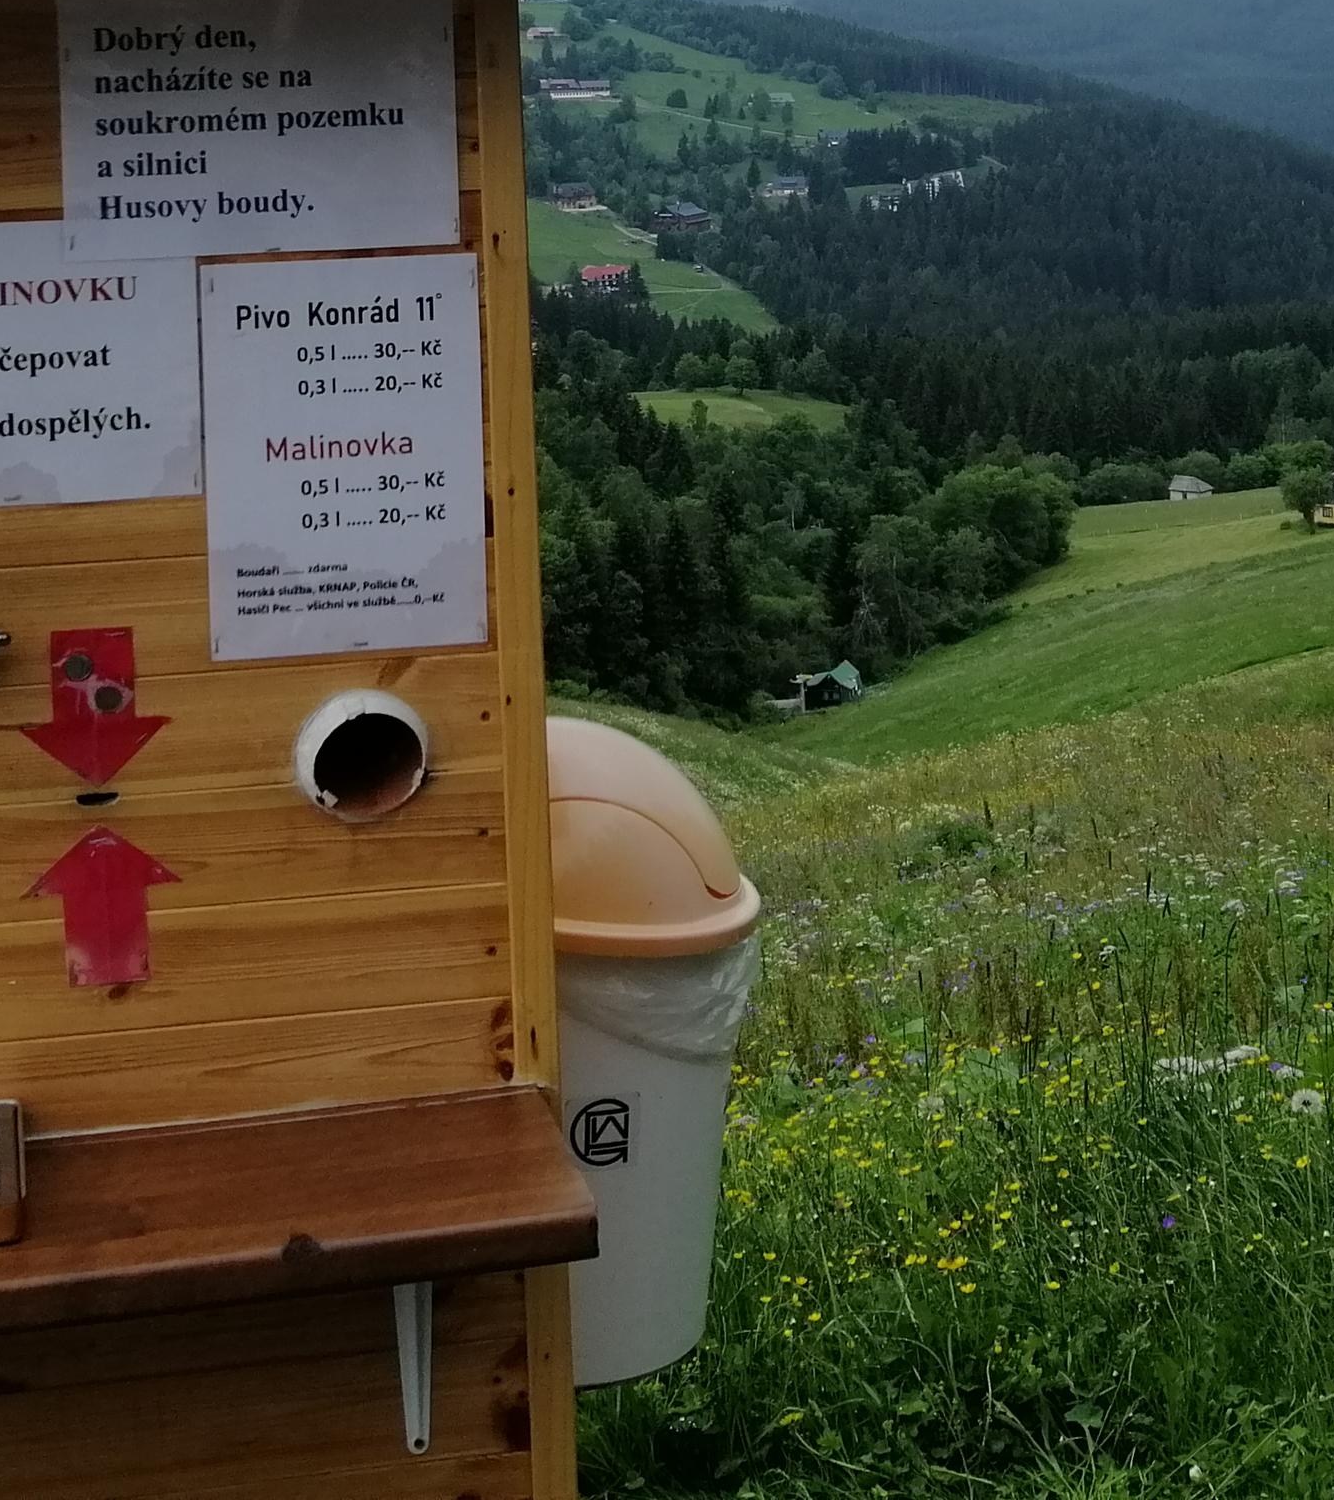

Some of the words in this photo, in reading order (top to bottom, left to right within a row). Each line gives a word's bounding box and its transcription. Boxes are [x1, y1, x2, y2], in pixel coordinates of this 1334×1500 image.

[93, 24, 185, 56] Dobrý
[195, 24, 256, 54] den,
[94, 68, 232, 94] nacházíte
[242, 69, 269, 90] se
[279, 67, 313, 89] na
[96, 106, 267, 136] soukromém
[276, 102, 405, 137] pozemku
[97, 160, 113, 178] a
[123, 150, 208, 178] silnici
[98, 194, 207, 223] Husovy
[217, 188, 316, 219] boudy.
[235, 304, 291, 331] Pivo
[307, 295, 400, 328] Konrád
[297, 346, 325, 365] 0,5
[421, 339, 442, 357] Kč
[297, 379, 326, 398] 0,3
[422, 372, 443, 390] Kč
[266, 431, 414, 463] Malinovka
[300, 479, 329, 498] 0,5
[424, 471, 445, 489] Kč
[301, 513, 330, 531] 0,3
[425, 505, 446, 522] Kč
[308, 562, 348, 574] zdarma
[363, 580, 398, 591] Policie
[272, 603, 292, 613] Pec
[347, 600, 359, 609] ve
